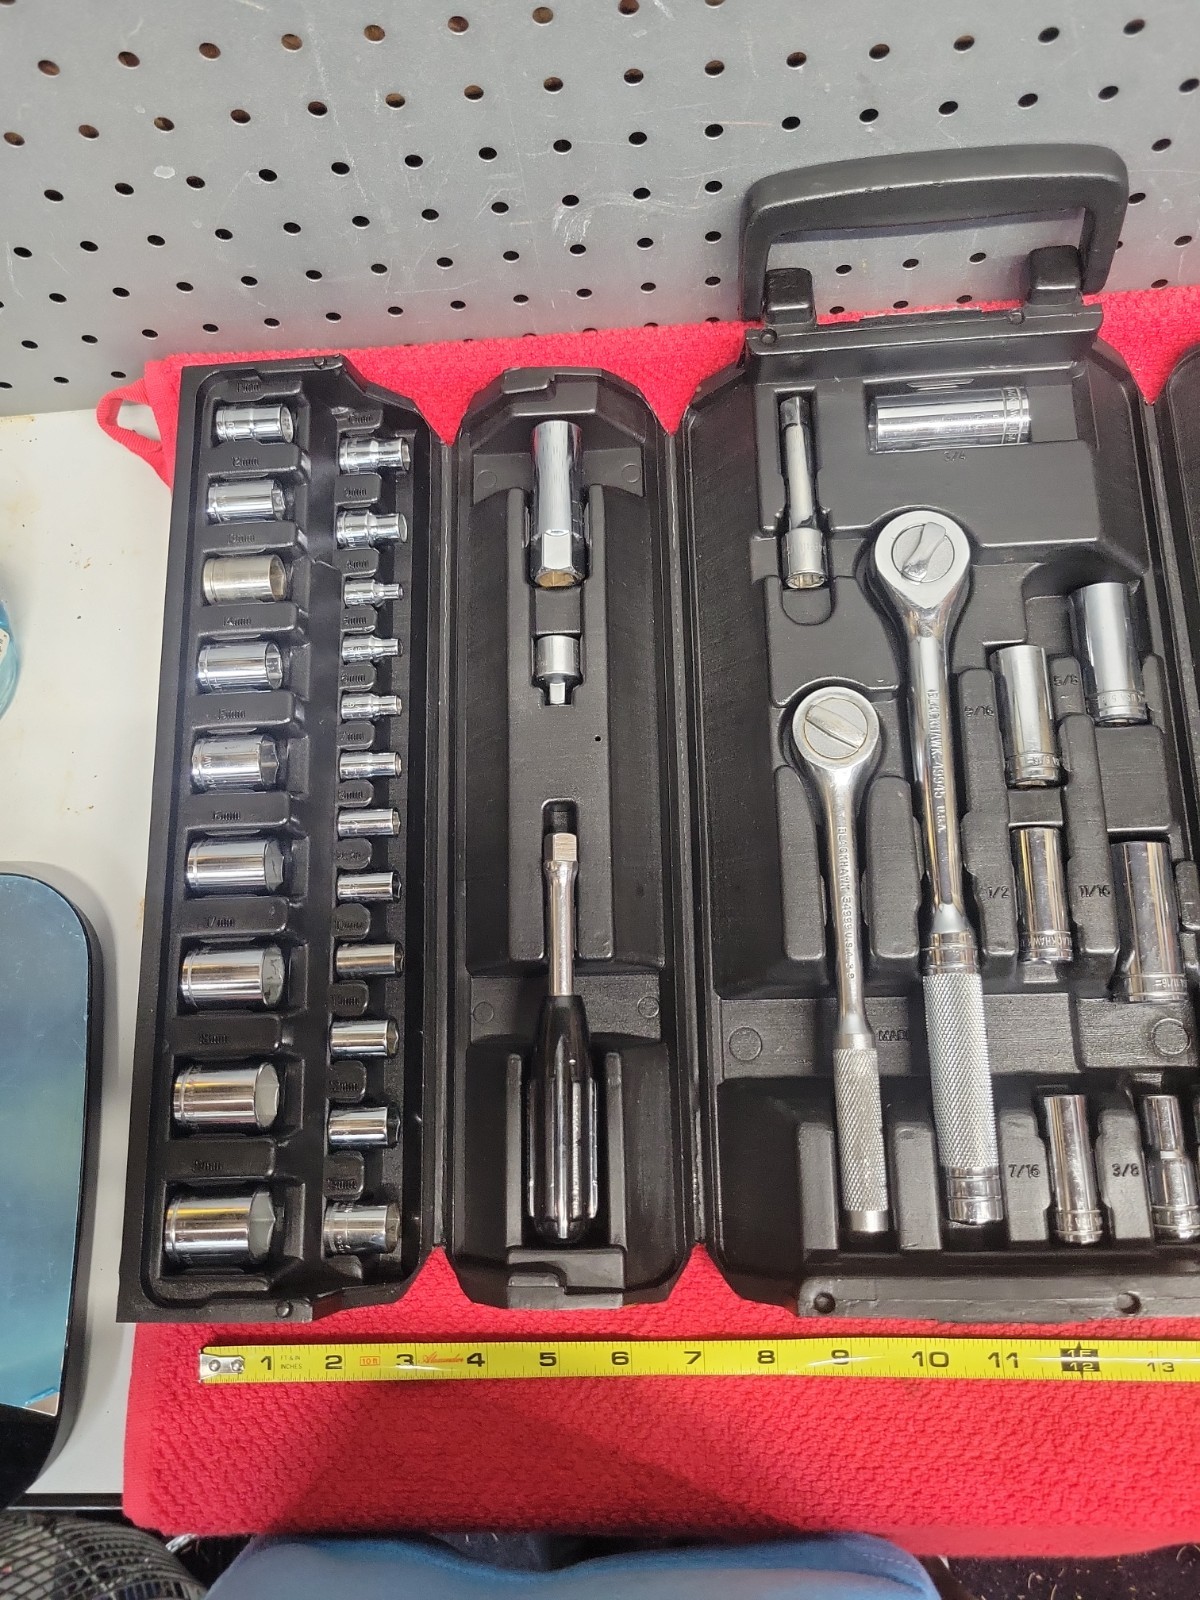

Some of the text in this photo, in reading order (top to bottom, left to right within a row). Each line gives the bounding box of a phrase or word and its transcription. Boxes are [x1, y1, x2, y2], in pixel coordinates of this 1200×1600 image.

[836, 827, 850, 892] BLACKHAWK
[987, 885, 1009, 899] 1/2
[1078, 884, 1110, 898] 11/16
[1007, 1163, 1041, 1178] 7/16
[1111, 1163, 1139, 1177] 3/8
[260, 1355, 272, 1371] 1
[324, 1354, 343, 1370] 2
[361, 1357, 370, 1365] 10
[395, 1353, 414, 1367] 3
[466, 1352, 486, 1368] 4
[539, 1352, 557, 1367] 5
[611, 1351, 630, 1366] 6
[684, 1351, 702, 1365] 7
[757, 1350, 776, 1365] 8
[831, 1349, 850, 1365] 9
[911, 1351, 950, 1368] 10
[987, 1352, 1019, 1369] 11
[1069, 1361, 1095, 1371] 12
[1146, 1361, 1175, 1373] 13
